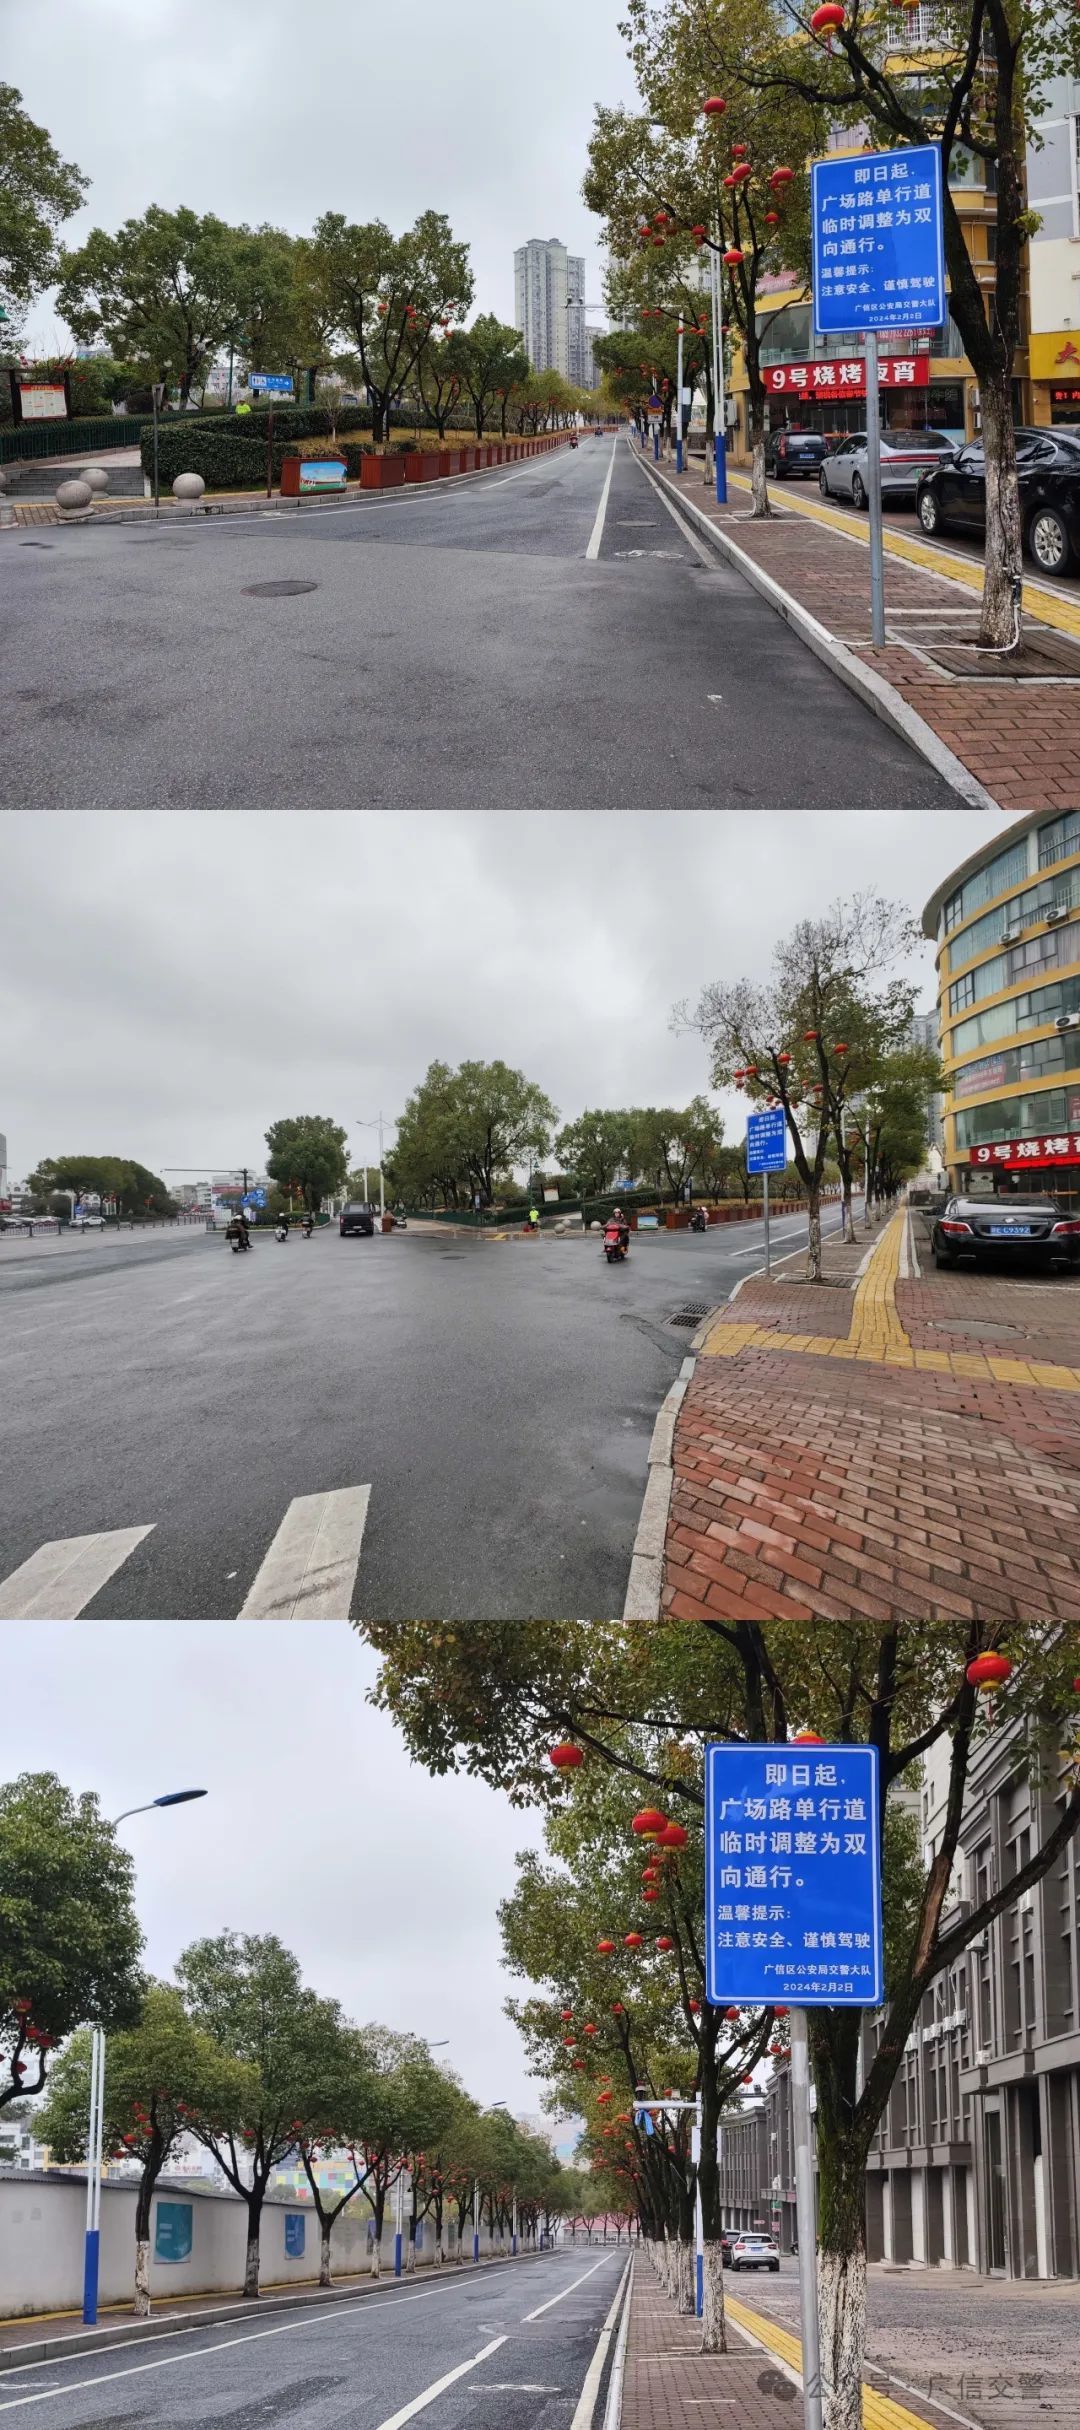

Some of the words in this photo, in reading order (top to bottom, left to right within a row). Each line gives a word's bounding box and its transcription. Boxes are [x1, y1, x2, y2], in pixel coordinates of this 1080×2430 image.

[822, 183, 932, 212] 广场路单行道
[822, 207, 932, 235] 临时调整为双
[823, 237, 885, 257] 向通行。
[821, 264, 874, 279] 温馨提示：
[719, 1798, 867, 1822] 广场路单行道
[719, 1832, 867, 1856] 临时调整为双
[720, 1865, 805, 1889] 向通行。
[717, 1904, 791, 1921] 温馨提示：
[764, 1964, 872, 1977] 广信区公安局交警大队
[783, 1982, 854, 1994] 2024年2月2日
